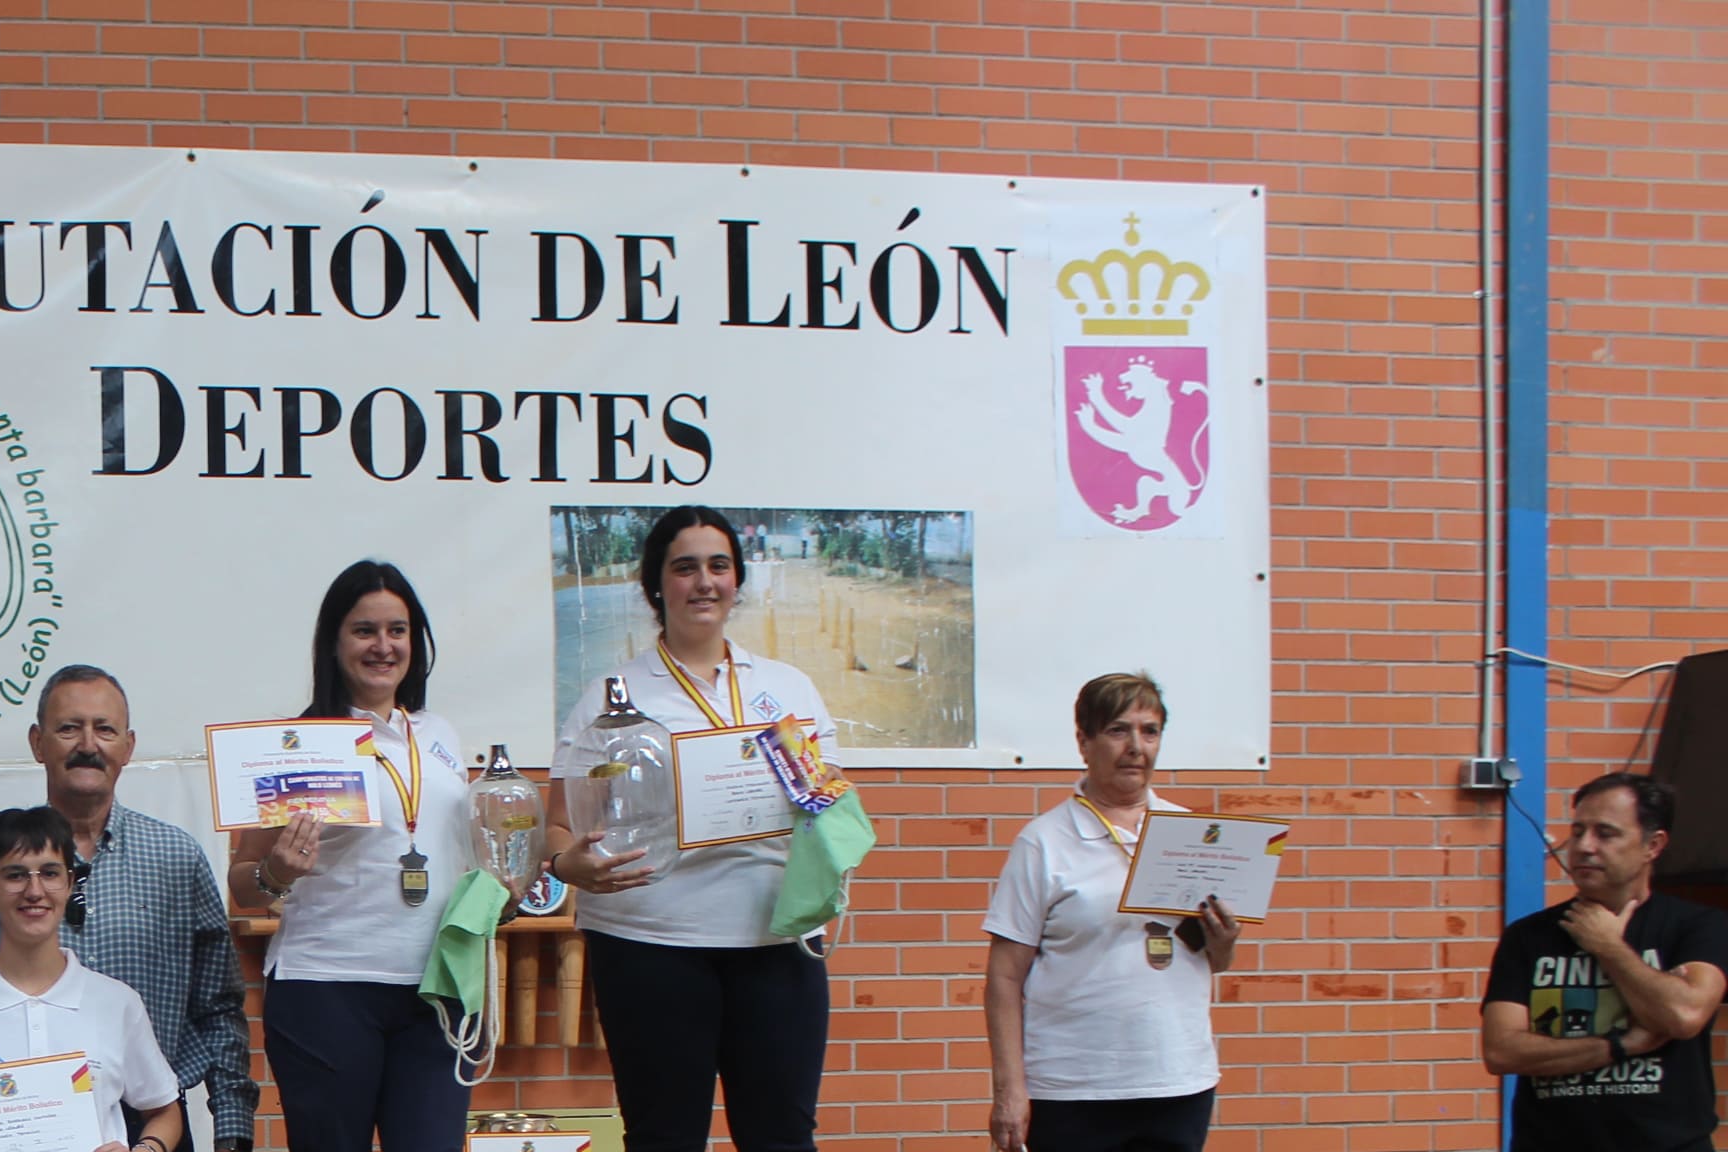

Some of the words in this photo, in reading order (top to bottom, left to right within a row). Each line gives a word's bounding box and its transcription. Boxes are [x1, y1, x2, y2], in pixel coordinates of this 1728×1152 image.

[531, 232, 678, 325] DE
[719, 207, 1017, 336] LEÓN
[91, 366, 712, 486] DEPORTES
[16, 469, 64, 609] barbara"
[255, 777, 281, 829] 2025
[1533, 949, 1662, 987] CIÑA
[1586, 1085, 1602, 1096] DE
[1605, 1083, 1661, 1095] HISTORIA
